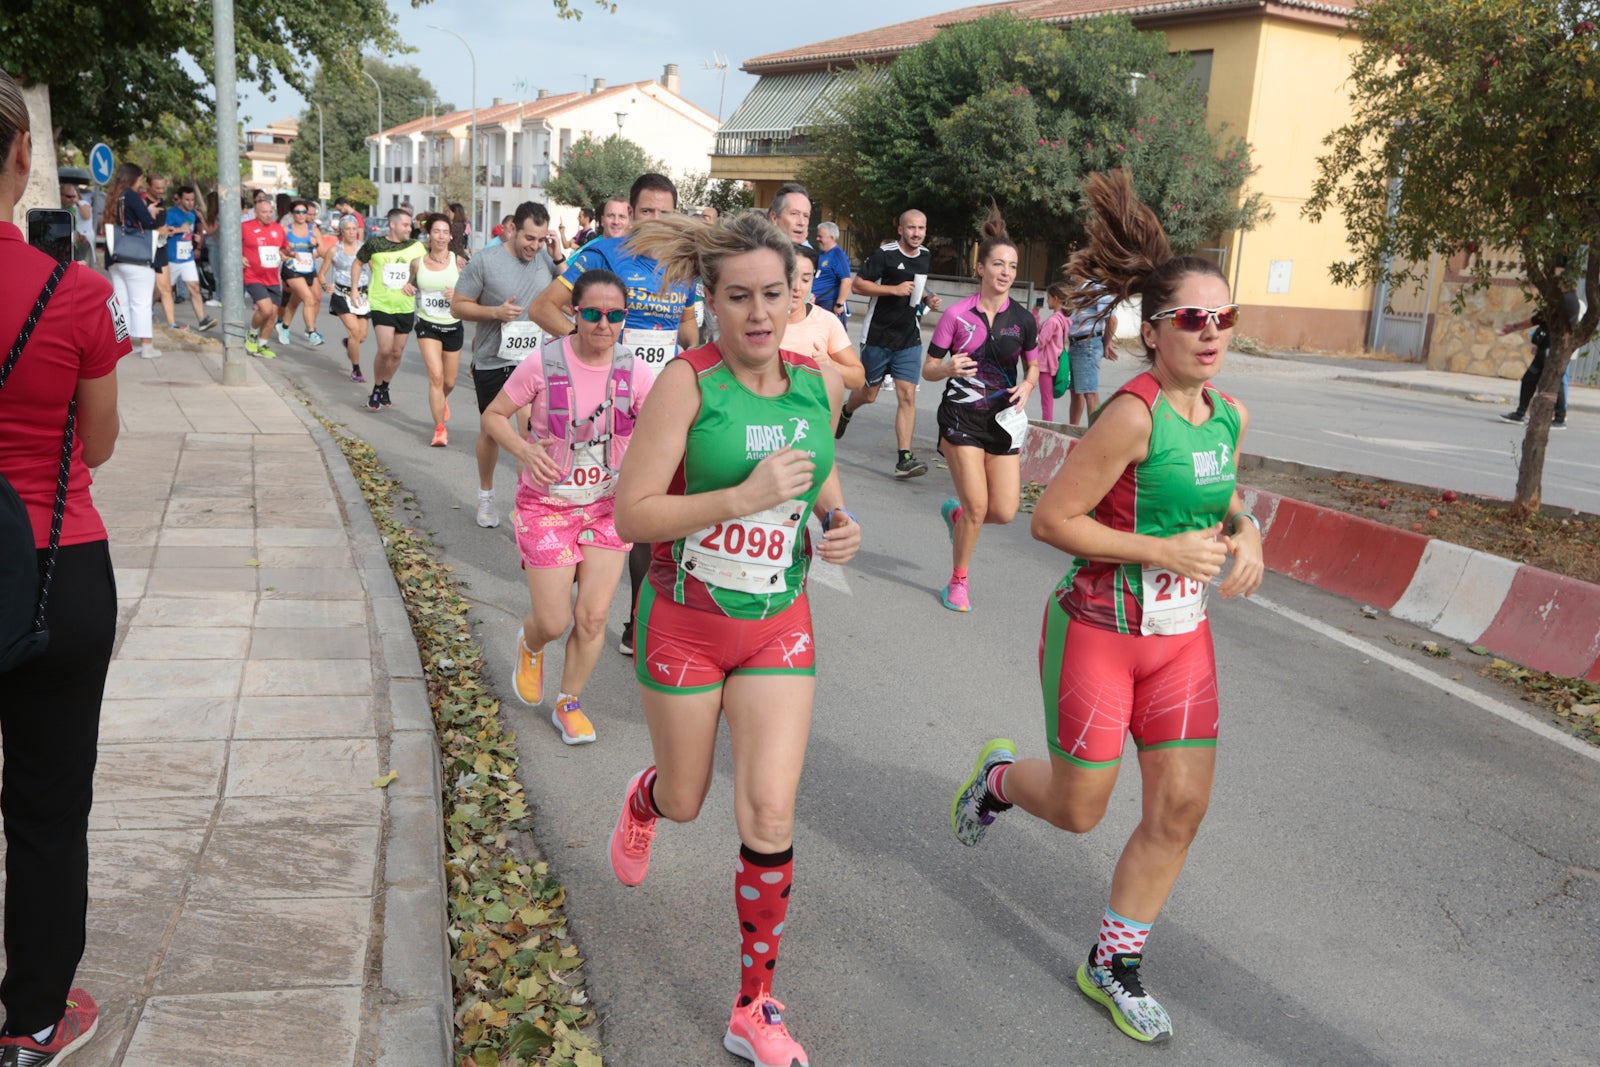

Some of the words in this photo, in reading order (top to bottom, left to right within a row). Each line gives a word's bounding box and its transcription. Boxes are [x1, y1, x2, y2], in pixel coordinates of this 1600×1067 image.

[389, 271, 407, 280] 726
[425, 298, 451, 308] 3085
[627, 301, 671, 313] ARATON
[506, 336, 537, 349] 3038
[635, 346, 665, 364] 689
[539, 519, 569, 528] adidas
[699, 520, 785, 561] 2098
